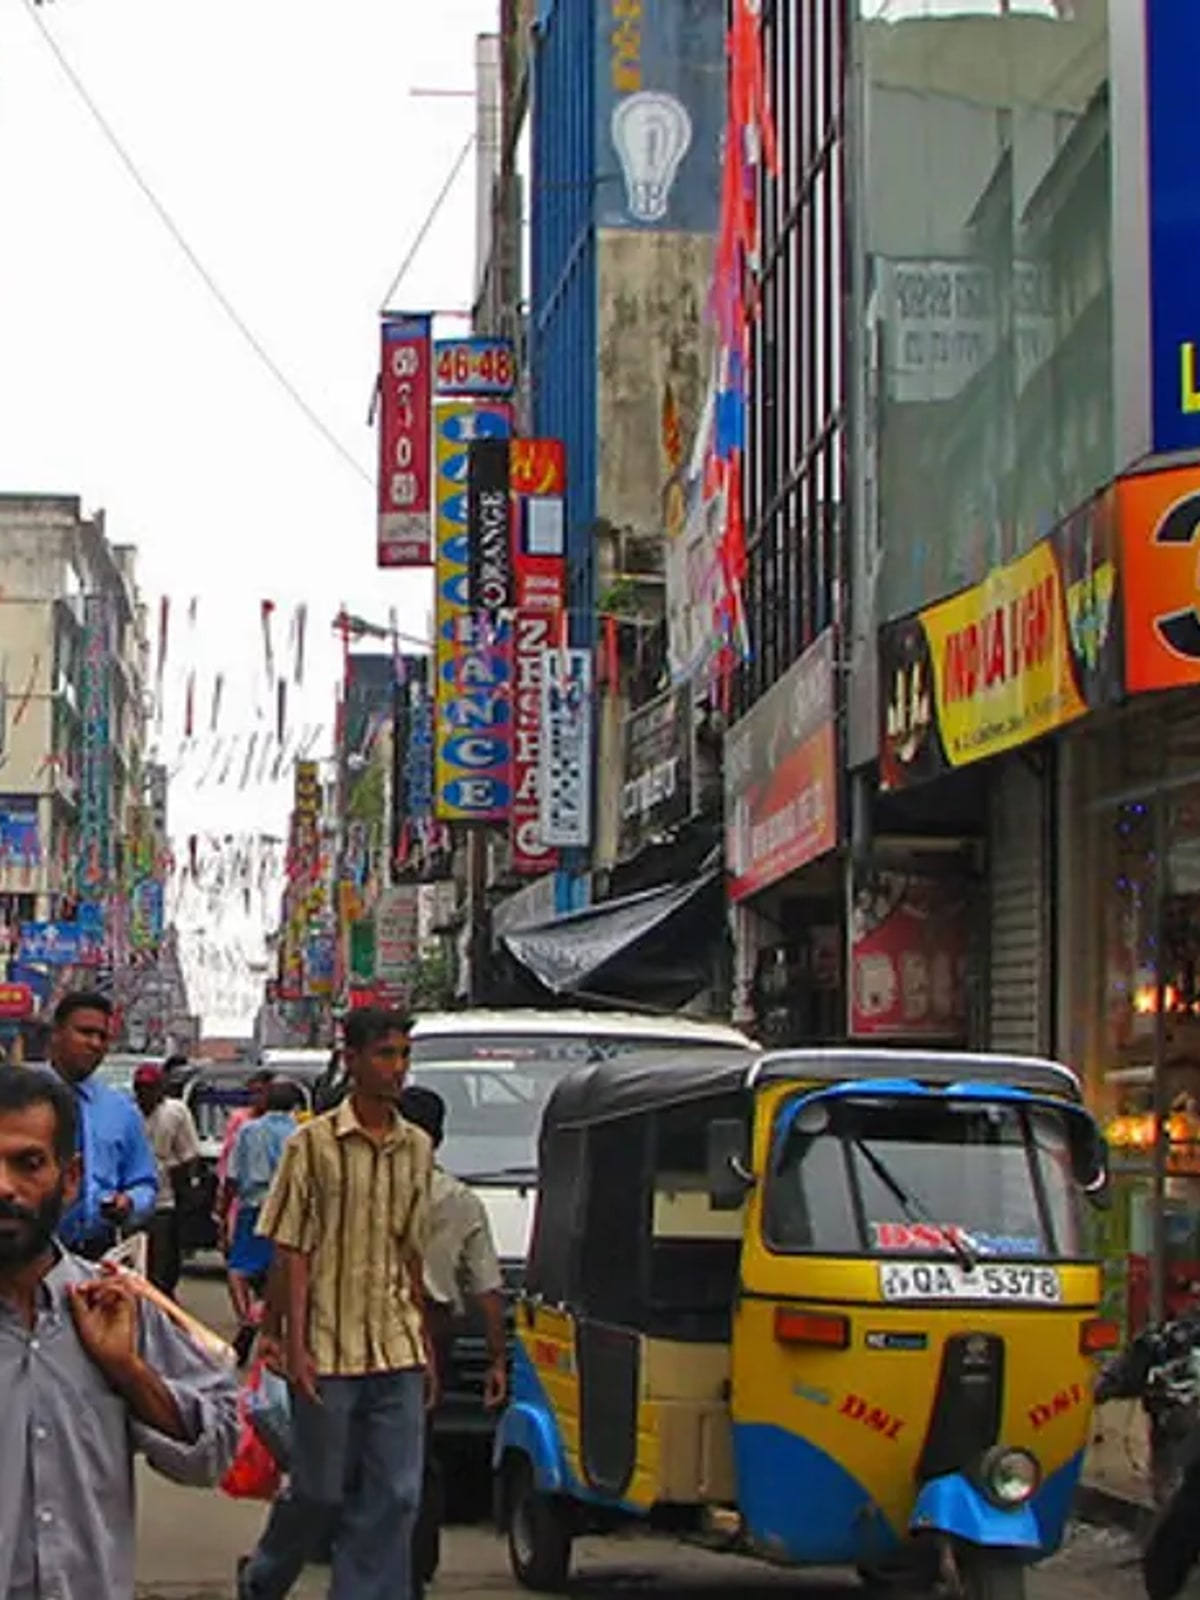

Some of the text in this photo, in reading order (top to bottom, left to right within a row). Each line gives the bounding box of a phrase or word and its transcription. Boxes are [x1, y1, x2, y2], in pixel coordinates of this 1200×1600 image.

[437, 346, 511, 386] 46-48
[479, 489, 507, 608] ORANGE
[983, 1268, 1058, 1298] 5378
